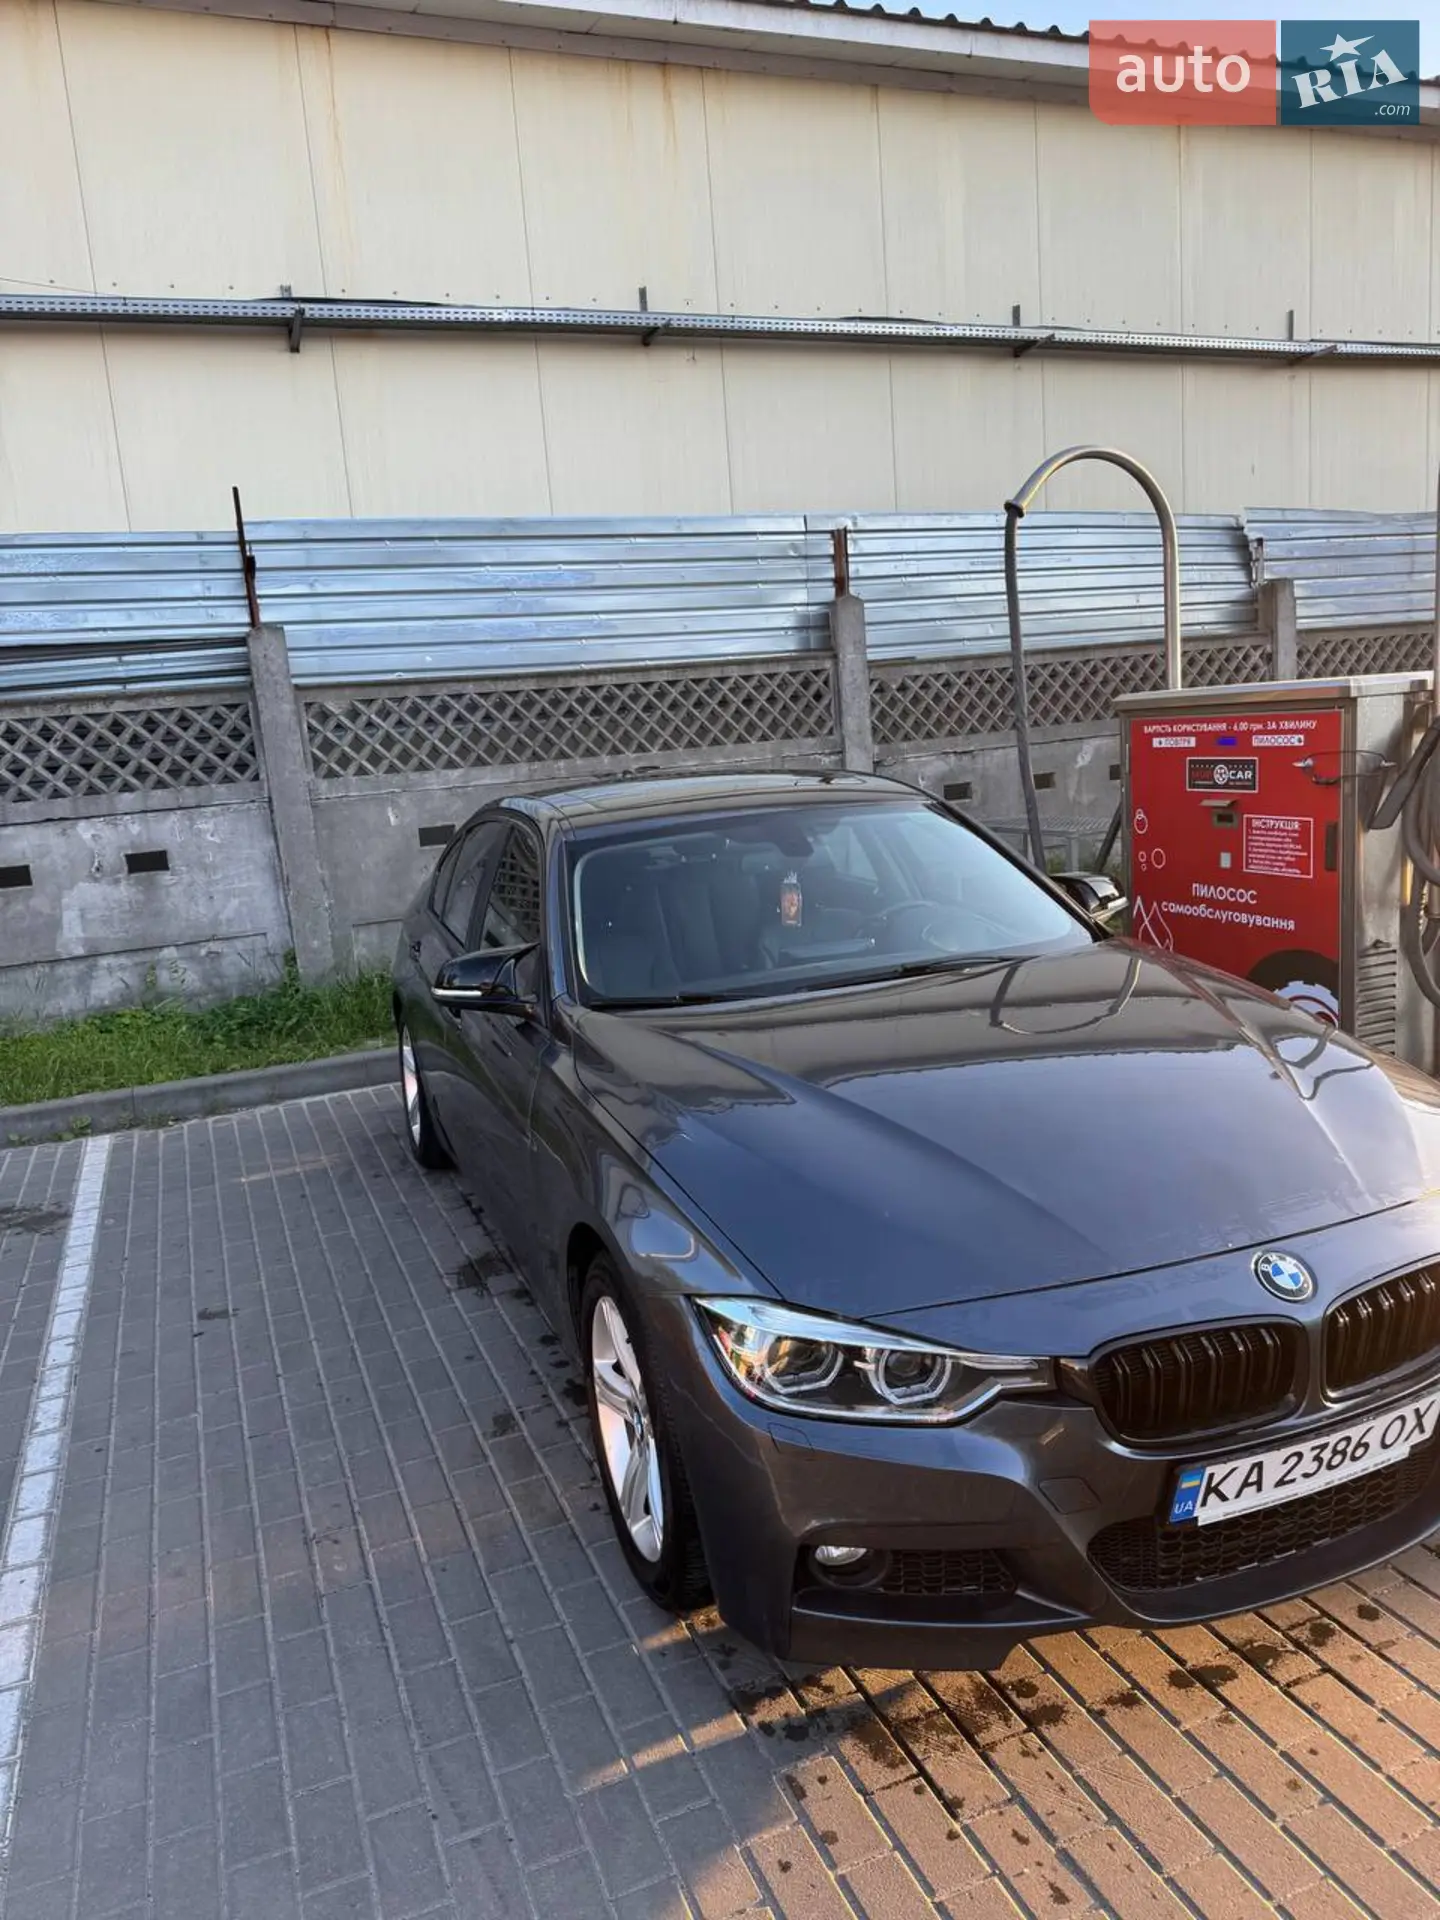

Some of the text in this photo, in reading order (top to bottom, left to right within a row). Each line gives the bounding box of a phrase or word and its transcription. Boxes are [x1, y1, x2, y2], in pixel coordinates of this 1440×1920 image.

[1266, 720, 1278, 730] ЗА
[1279, 719, 1318, 730] ХВИЛИНУ
[1254, 735, 1296, 745] ПИЛОСОС
[1229, 770, 1253, 780] CAR
[1192, 882, 1258, 905] ПИЛОСОС
[1161, 901, 1295, 931] самообслуговування
[1200, 1461, 1264, 1508] KA
[1273, 1425, 1375, 1488] 2386
[1380, 1399, 1437, 1450] OX
[1174, 1500, 1195, 1514] UA
